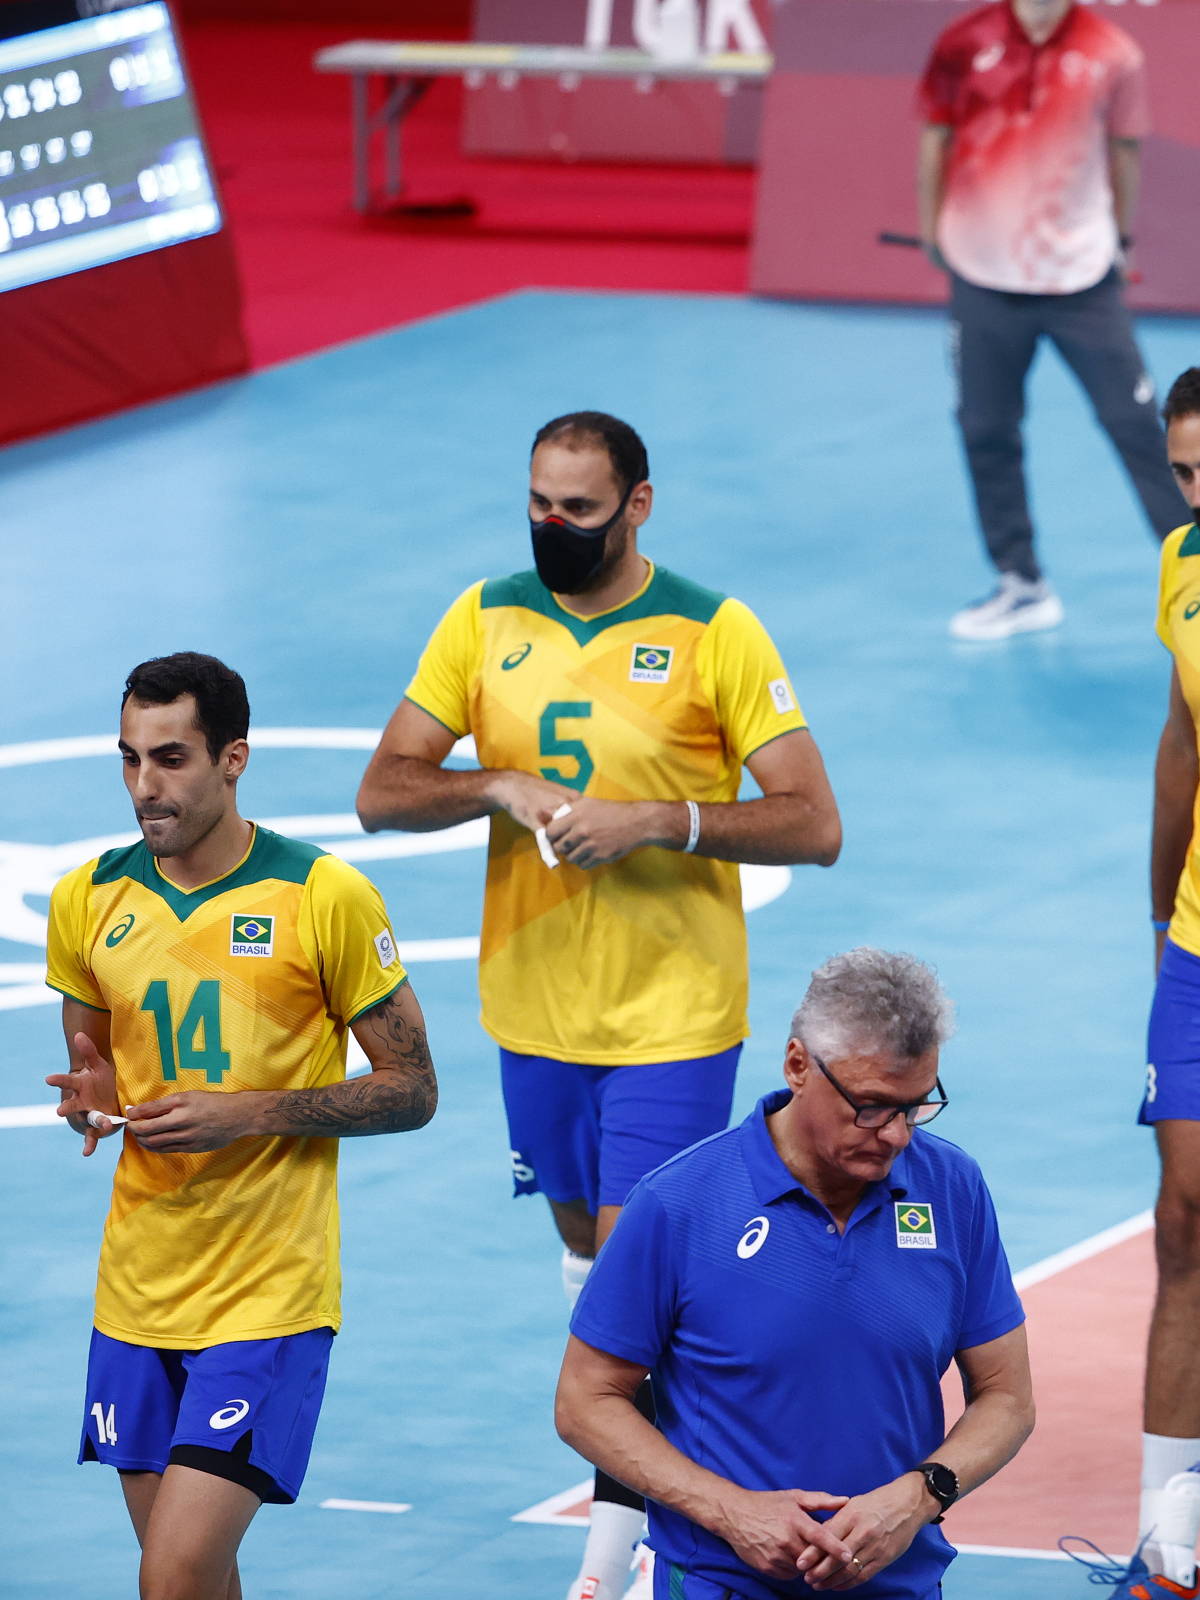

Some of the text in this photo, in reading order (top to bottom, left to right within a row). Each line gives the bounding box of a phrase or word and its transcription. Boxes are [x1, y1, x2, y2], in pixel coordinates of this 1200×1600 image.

[539, 701, 594, 794] 5
[232, 944, 270, 956] BRASIL
[139, 980, 231, 1083] 14
[899, 1235, 934, 1246] BRASIL
[90, 1402, 118, 1446] 14
